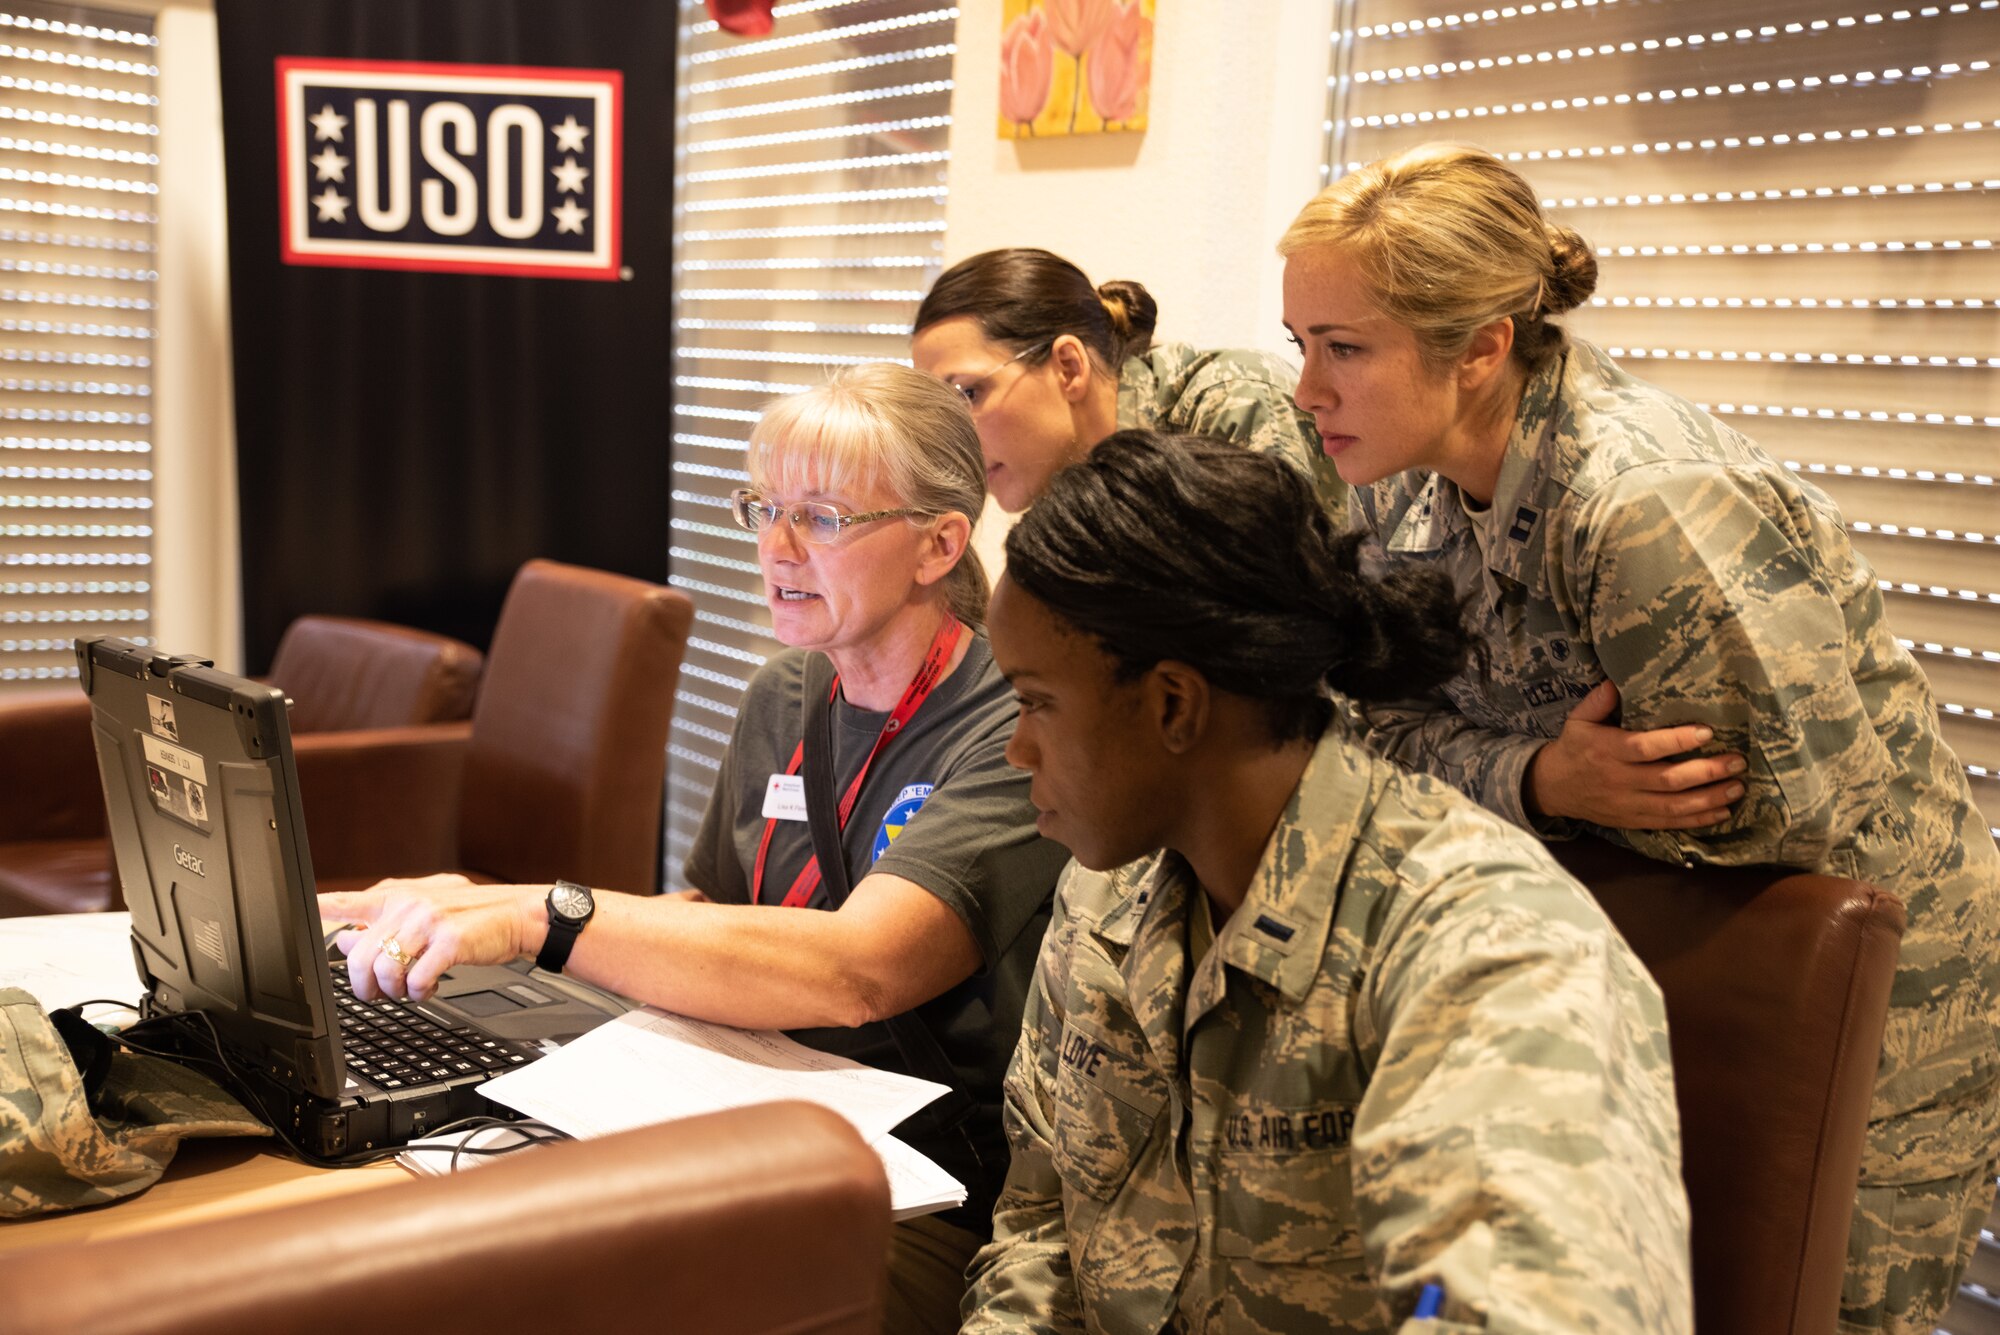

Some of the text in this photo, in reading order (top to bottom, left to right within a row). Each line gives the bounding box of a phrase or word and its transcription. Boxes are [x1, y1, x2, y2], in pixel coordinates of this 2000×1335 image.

[354, 98, 544, 240] USO
[173, 843, 205, 877] Getac
[1062, 1029, 1107, 1078] LOVE
[1228, 1114, 1254, 1148] U.S.
[1258, 1114, 1293, 1148] AIR
